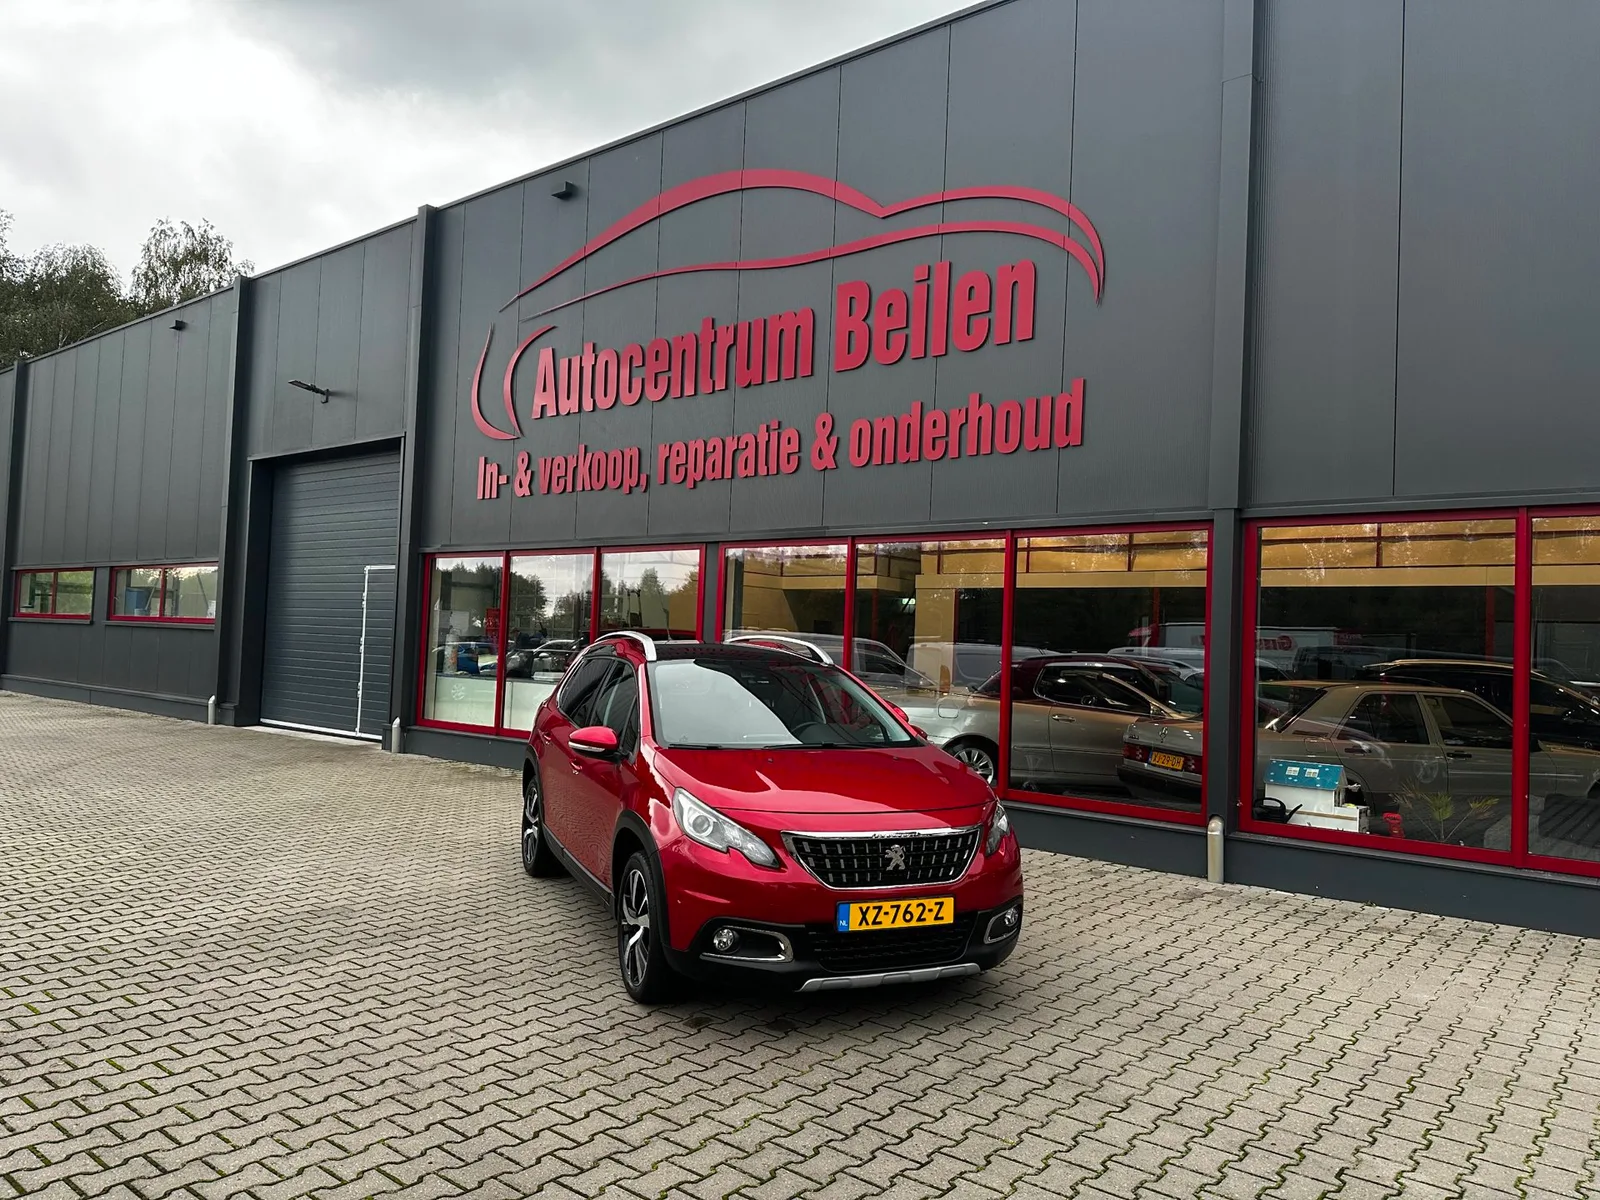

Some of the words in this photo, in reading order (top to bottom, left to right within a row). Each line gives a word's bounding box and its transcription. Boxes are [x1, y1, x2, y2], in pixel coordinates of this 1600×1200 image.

[532, 307, 815, 420] Autocentrum
[834, 260, 1037, 372] Beilen
[477, 457, 508, 500] In-
[514, 451, 533, 497] &
[538, 443, 648, 494] verkoop,
[657, 419, 800, 489] reparatie
[811, 412, 839, 471] &
[848, 378, 1085, 467] onderhoud
[858, 901, 945, 926] XZ-762-Z
